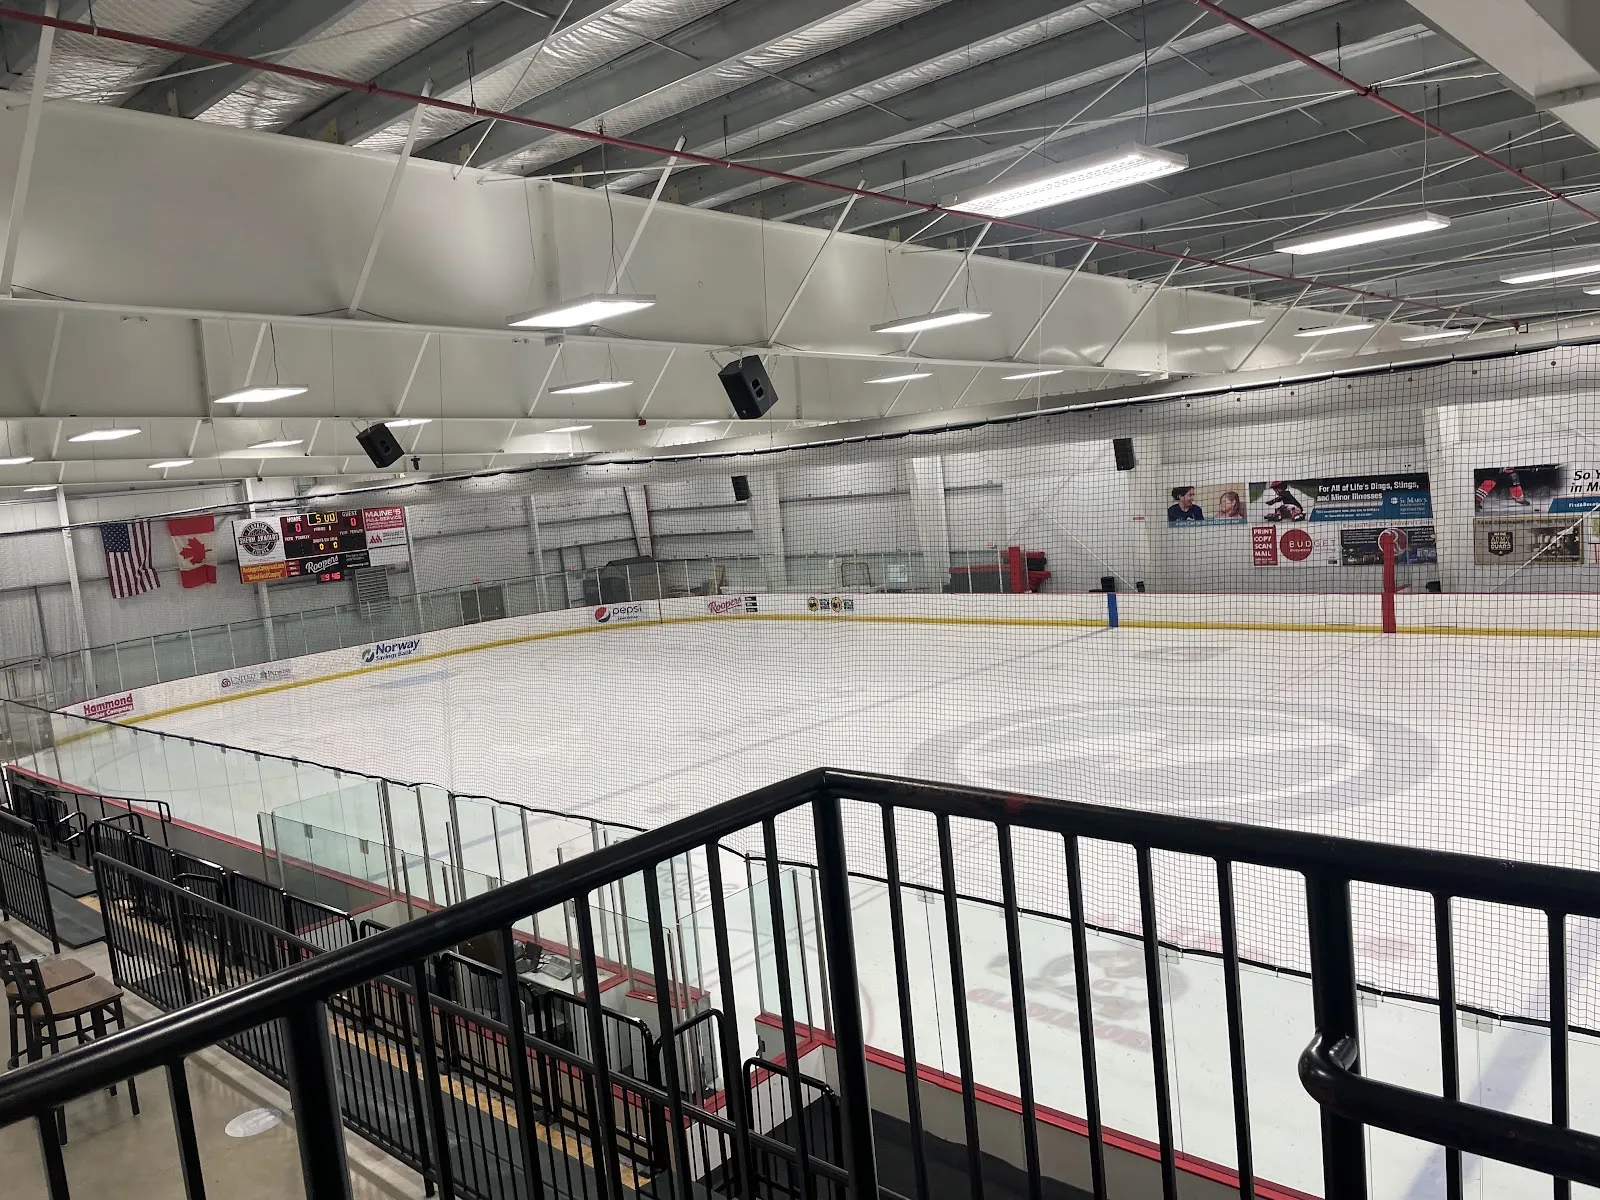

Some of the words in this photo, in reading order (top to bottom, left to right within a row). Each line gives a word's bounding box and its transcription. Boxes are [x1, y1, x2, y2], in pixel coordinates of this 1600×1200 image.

[1573, 470, 1591, 481] So
[1318, 485, 1330, 493] For
[1331, 484, 1340, 492] All
[1342, 483, 1350, 492] of
[1350, 483, 1369, 491] Life's
[1370, 482, 1393, 491] Dings,
[1393, 481, 1419, 490] Stings,
[1570, 482, 1583, 493] in
[1586, 481, 1600, 492] M
[1317, 494, 1330, 502] and
[1331, 493, 1350, 501] Minor
[1352, 492, 1383, 501] Illnesses
[286, 515, 302, 523] HOME
[365, 508, 402, 518] MAINE'S
[295, 522, 302, 533] 0
[350, 517, 357, 527] 0
[305, 555, 339, 573] Roopers
[612, 603, 642, 617] pepsi
[707, 596, 743, 614] Roopers
[376, 639, 420, 655] Norway
[375, 653, 397, 661] Savings
[397, 649, 413, 657] Bank
[83, 693, 133, 715] Hammond
[106, 704, 132, 715] Company
